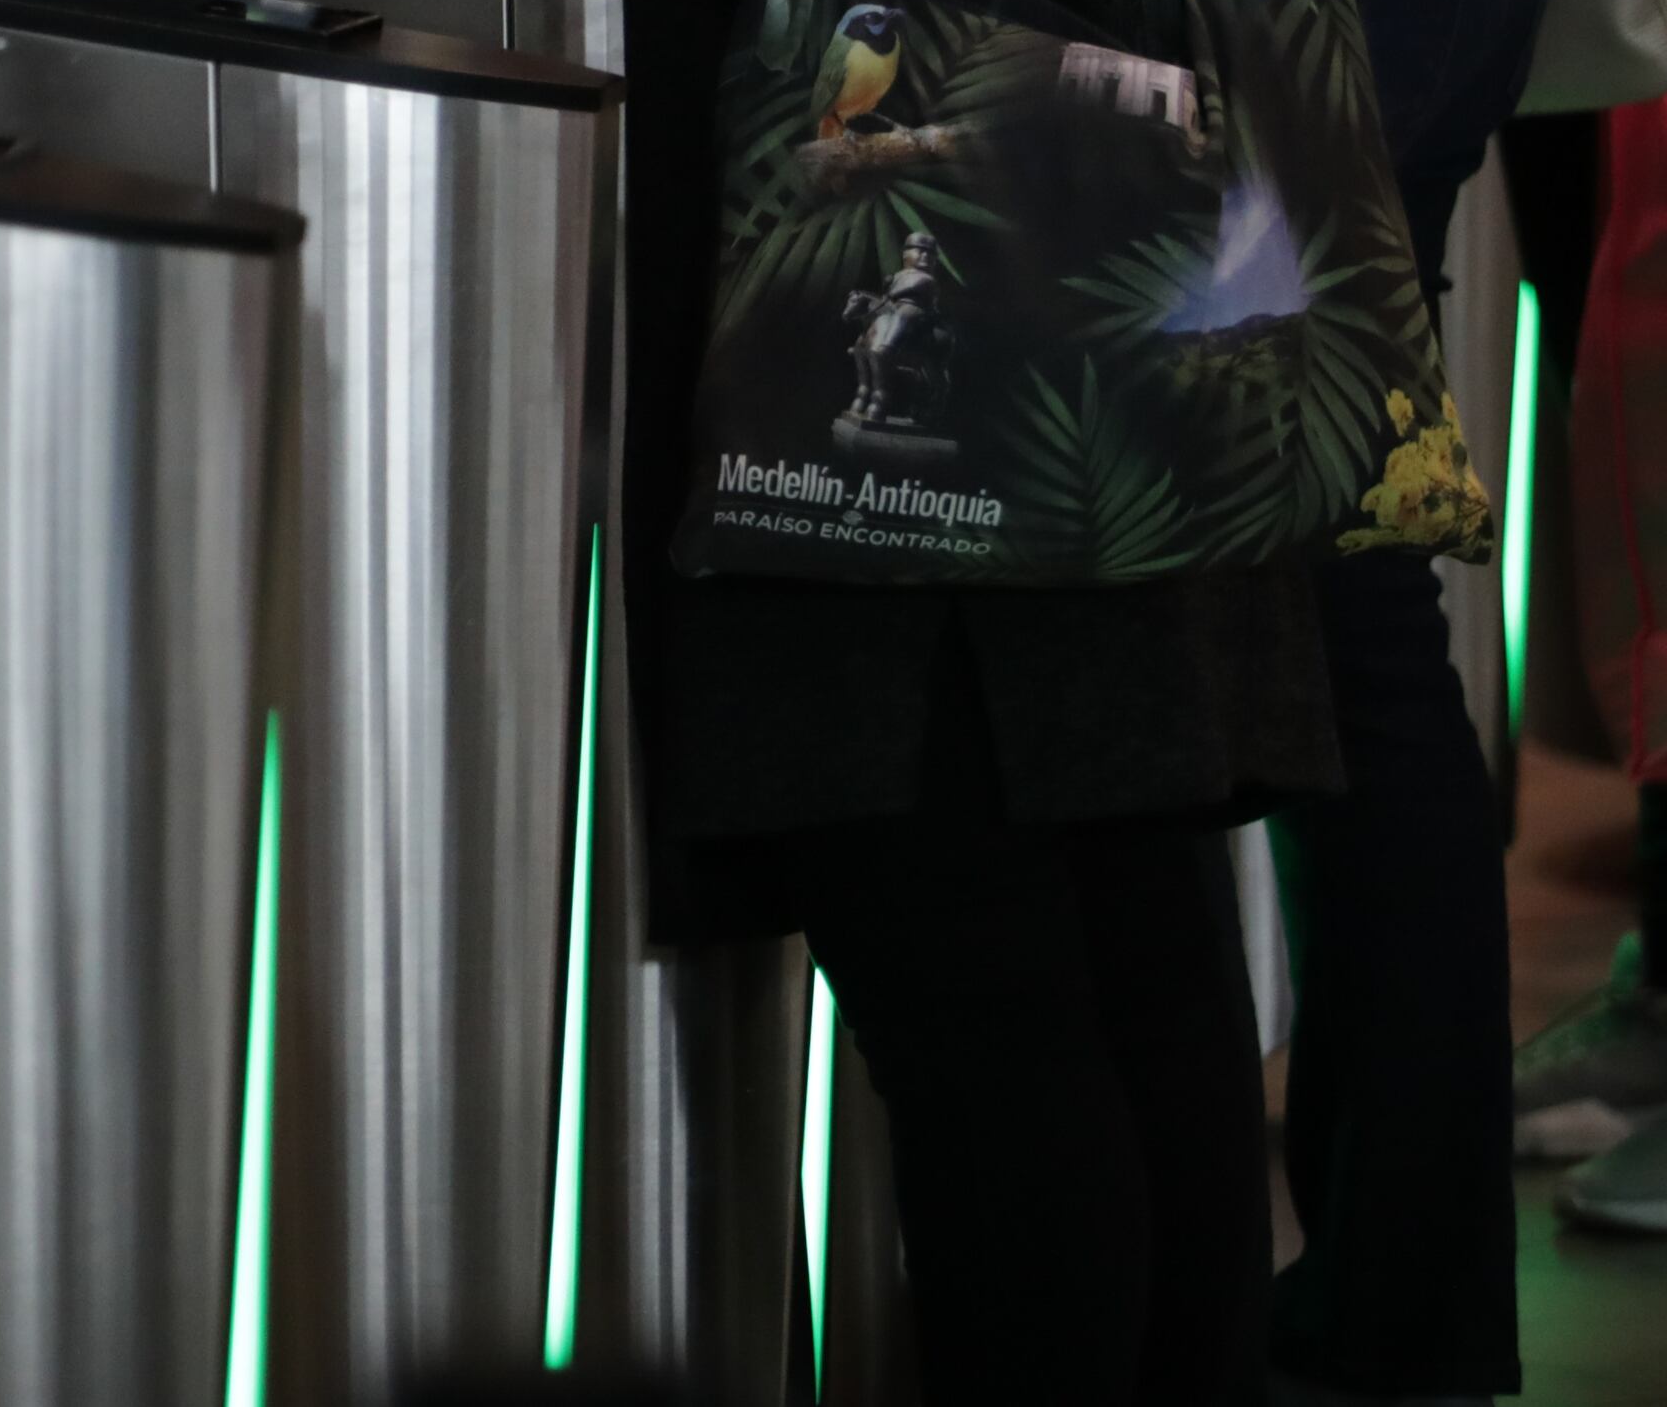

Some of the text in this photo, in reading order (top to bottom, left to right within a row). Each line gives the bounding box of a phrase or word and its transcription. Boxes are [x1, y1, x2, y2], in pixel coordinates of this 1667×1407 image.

[717, 453, 1003, 528] Medellín-Antioquia
[713, 511, 992, 555] PARAÍSO ENCONTRADO
